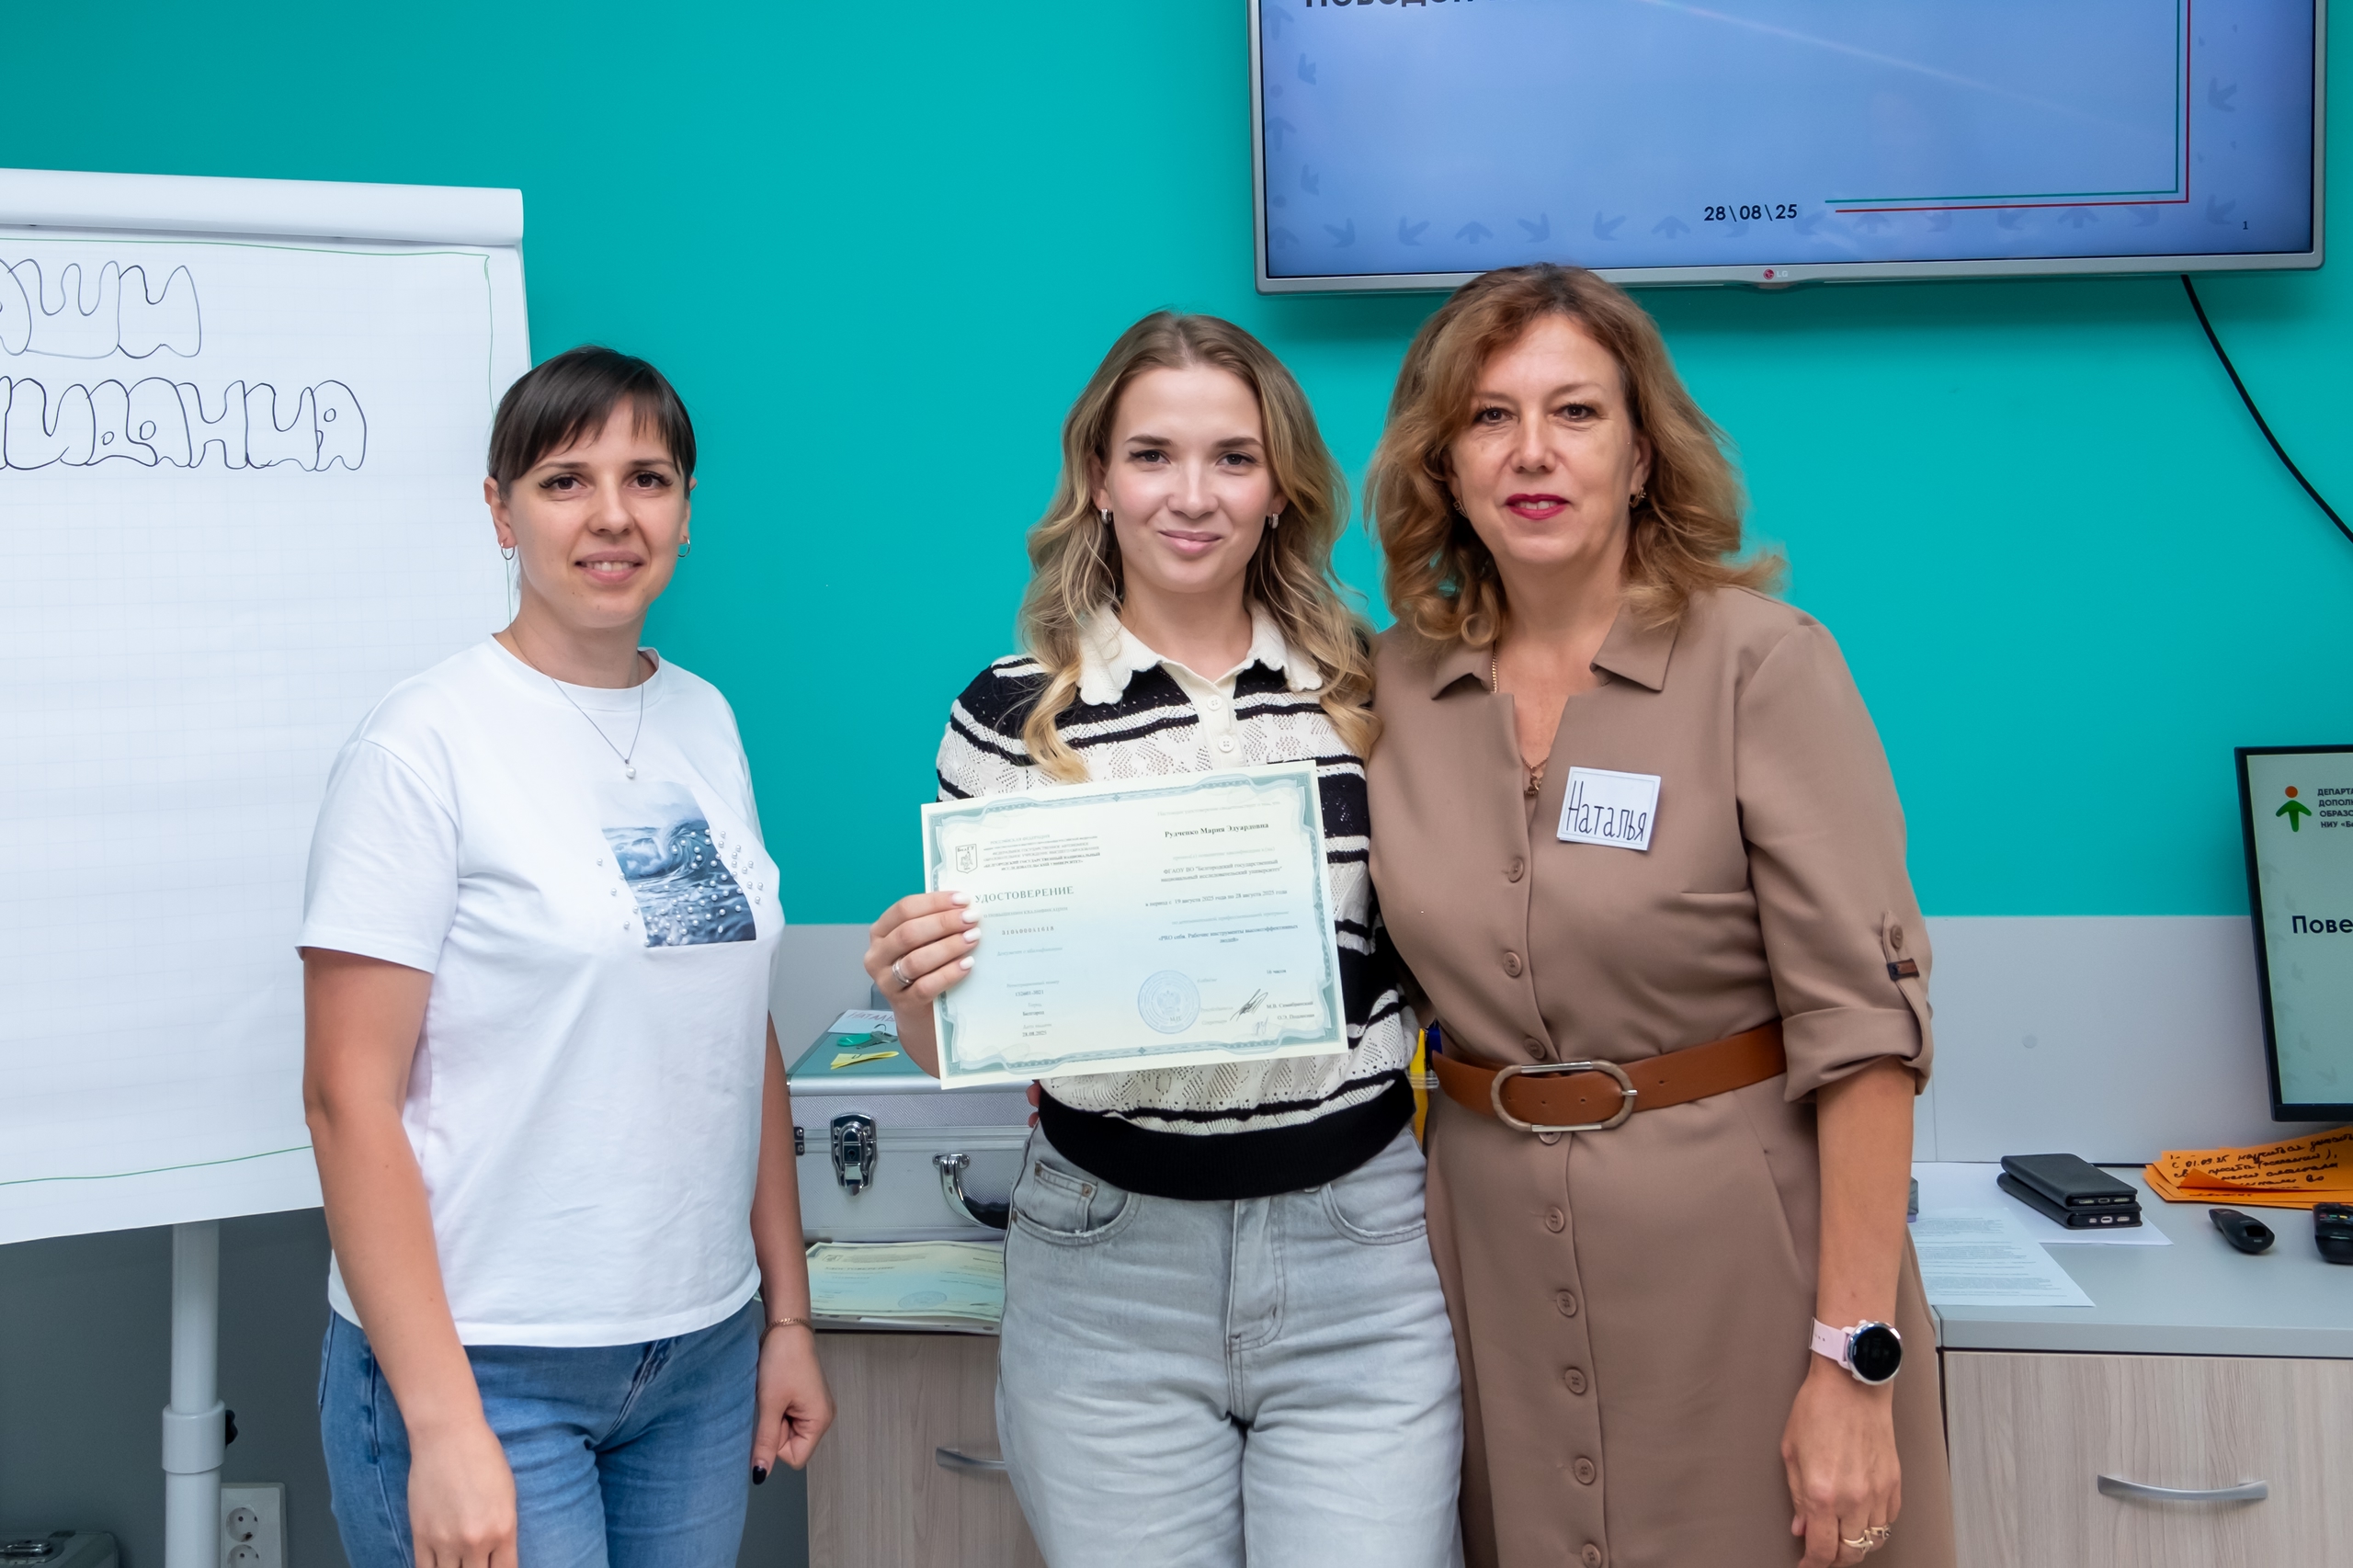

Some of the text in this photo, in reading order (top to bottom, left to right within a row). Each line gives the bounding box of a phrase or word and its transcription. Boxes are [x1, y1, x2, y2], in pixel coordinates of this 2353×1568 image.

[1704, 204, 1798, 222] 28\08\25
[2243, 221, 2248, 230] 1
[0, 376, 368, 472] ИДАНИЯ
[1566, 780, 1647, 842] Наталья
[2318, 799, 2353, 807] ДОПОЛ
[1165, 830, 1199, 838] Рудченко
[1226, 824, 1268, 832] Эдуардовна
[975, 886, 1074, 903] УДОСТОВЕРЕНИЕ
[2292, 915, 2353, 934] Пове
